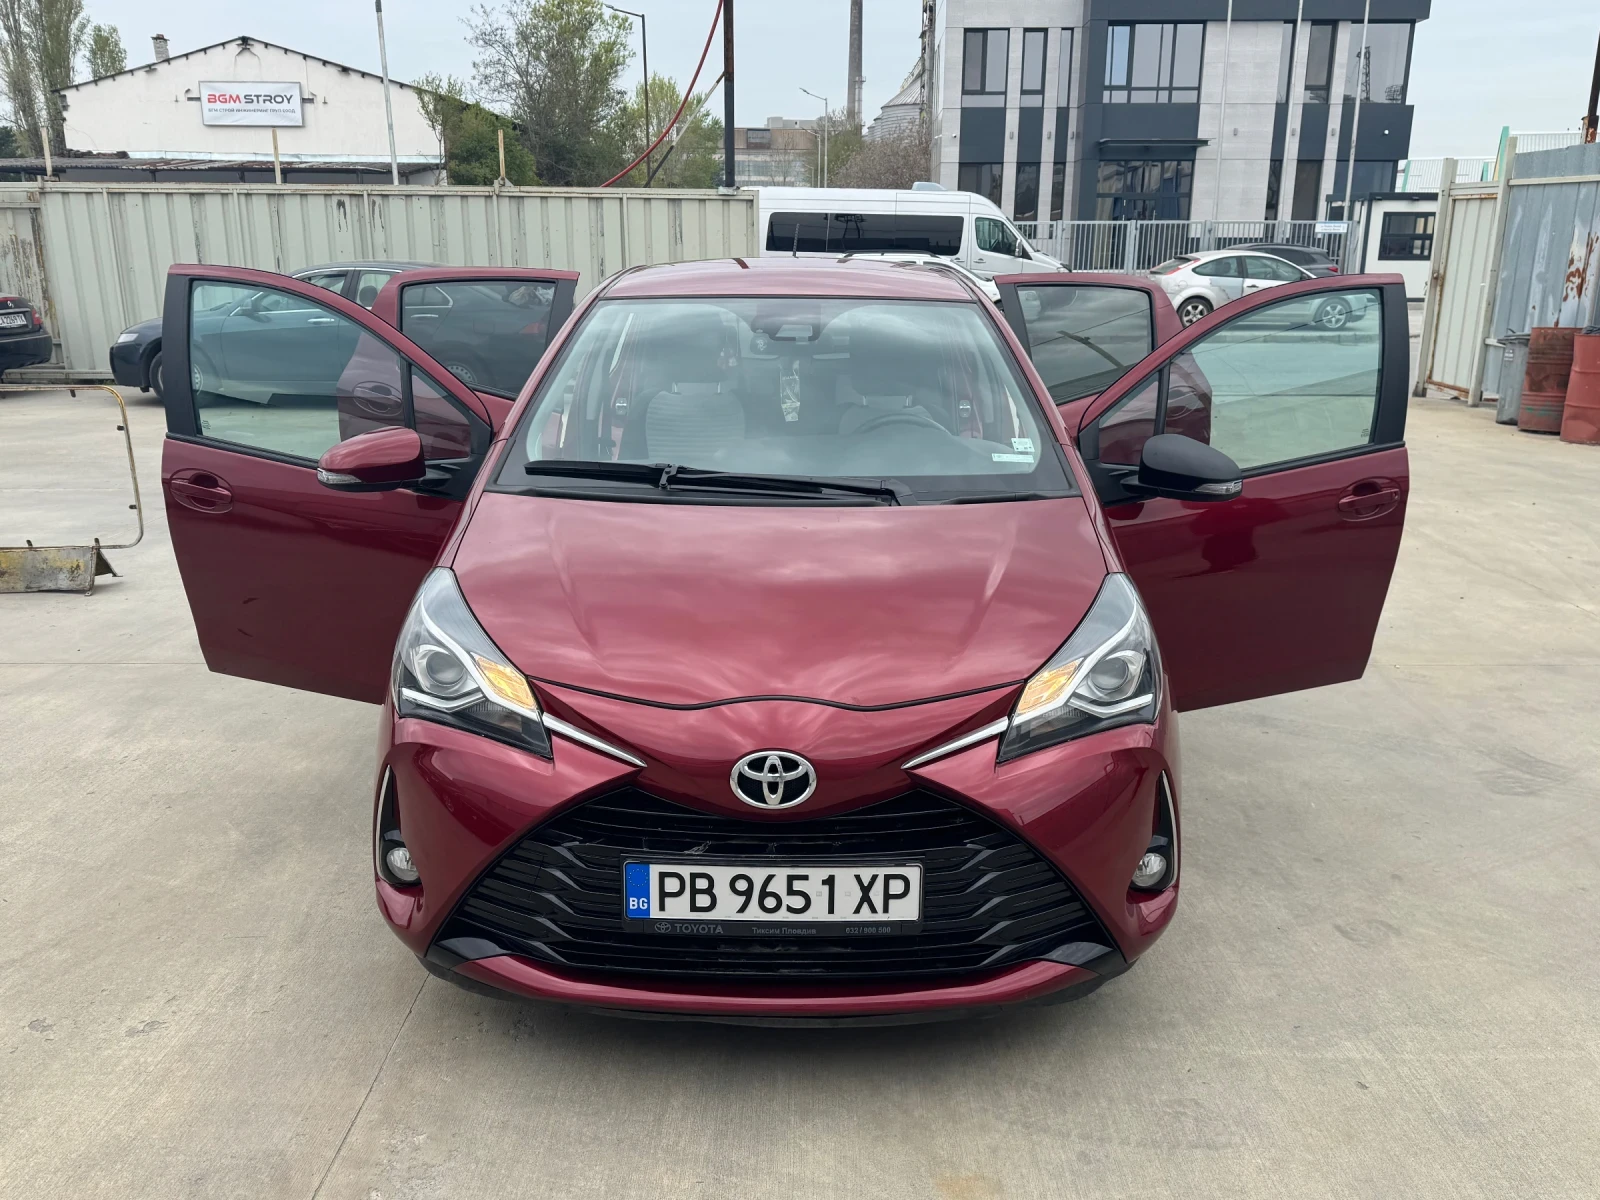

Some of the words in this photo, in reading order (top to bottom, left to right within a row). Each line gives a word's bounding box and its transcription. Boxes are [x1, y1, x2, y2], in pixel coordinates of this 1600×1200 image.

[207, 94, 241, 104] BGM
[244, 94, 293, 104] STROY
[658, 871, 718, 914] PB
[728, 873, 836, 915] 9651
[853, 874, 911, 915] XP
[629, 898, 648, 910] BG
[675, 923, 724, 935] TOYOTA
[751, 926, 781, 936] Тиксим
[782, 927, 817, 937] Пловдив
[878, 926, 891, 934] 500
